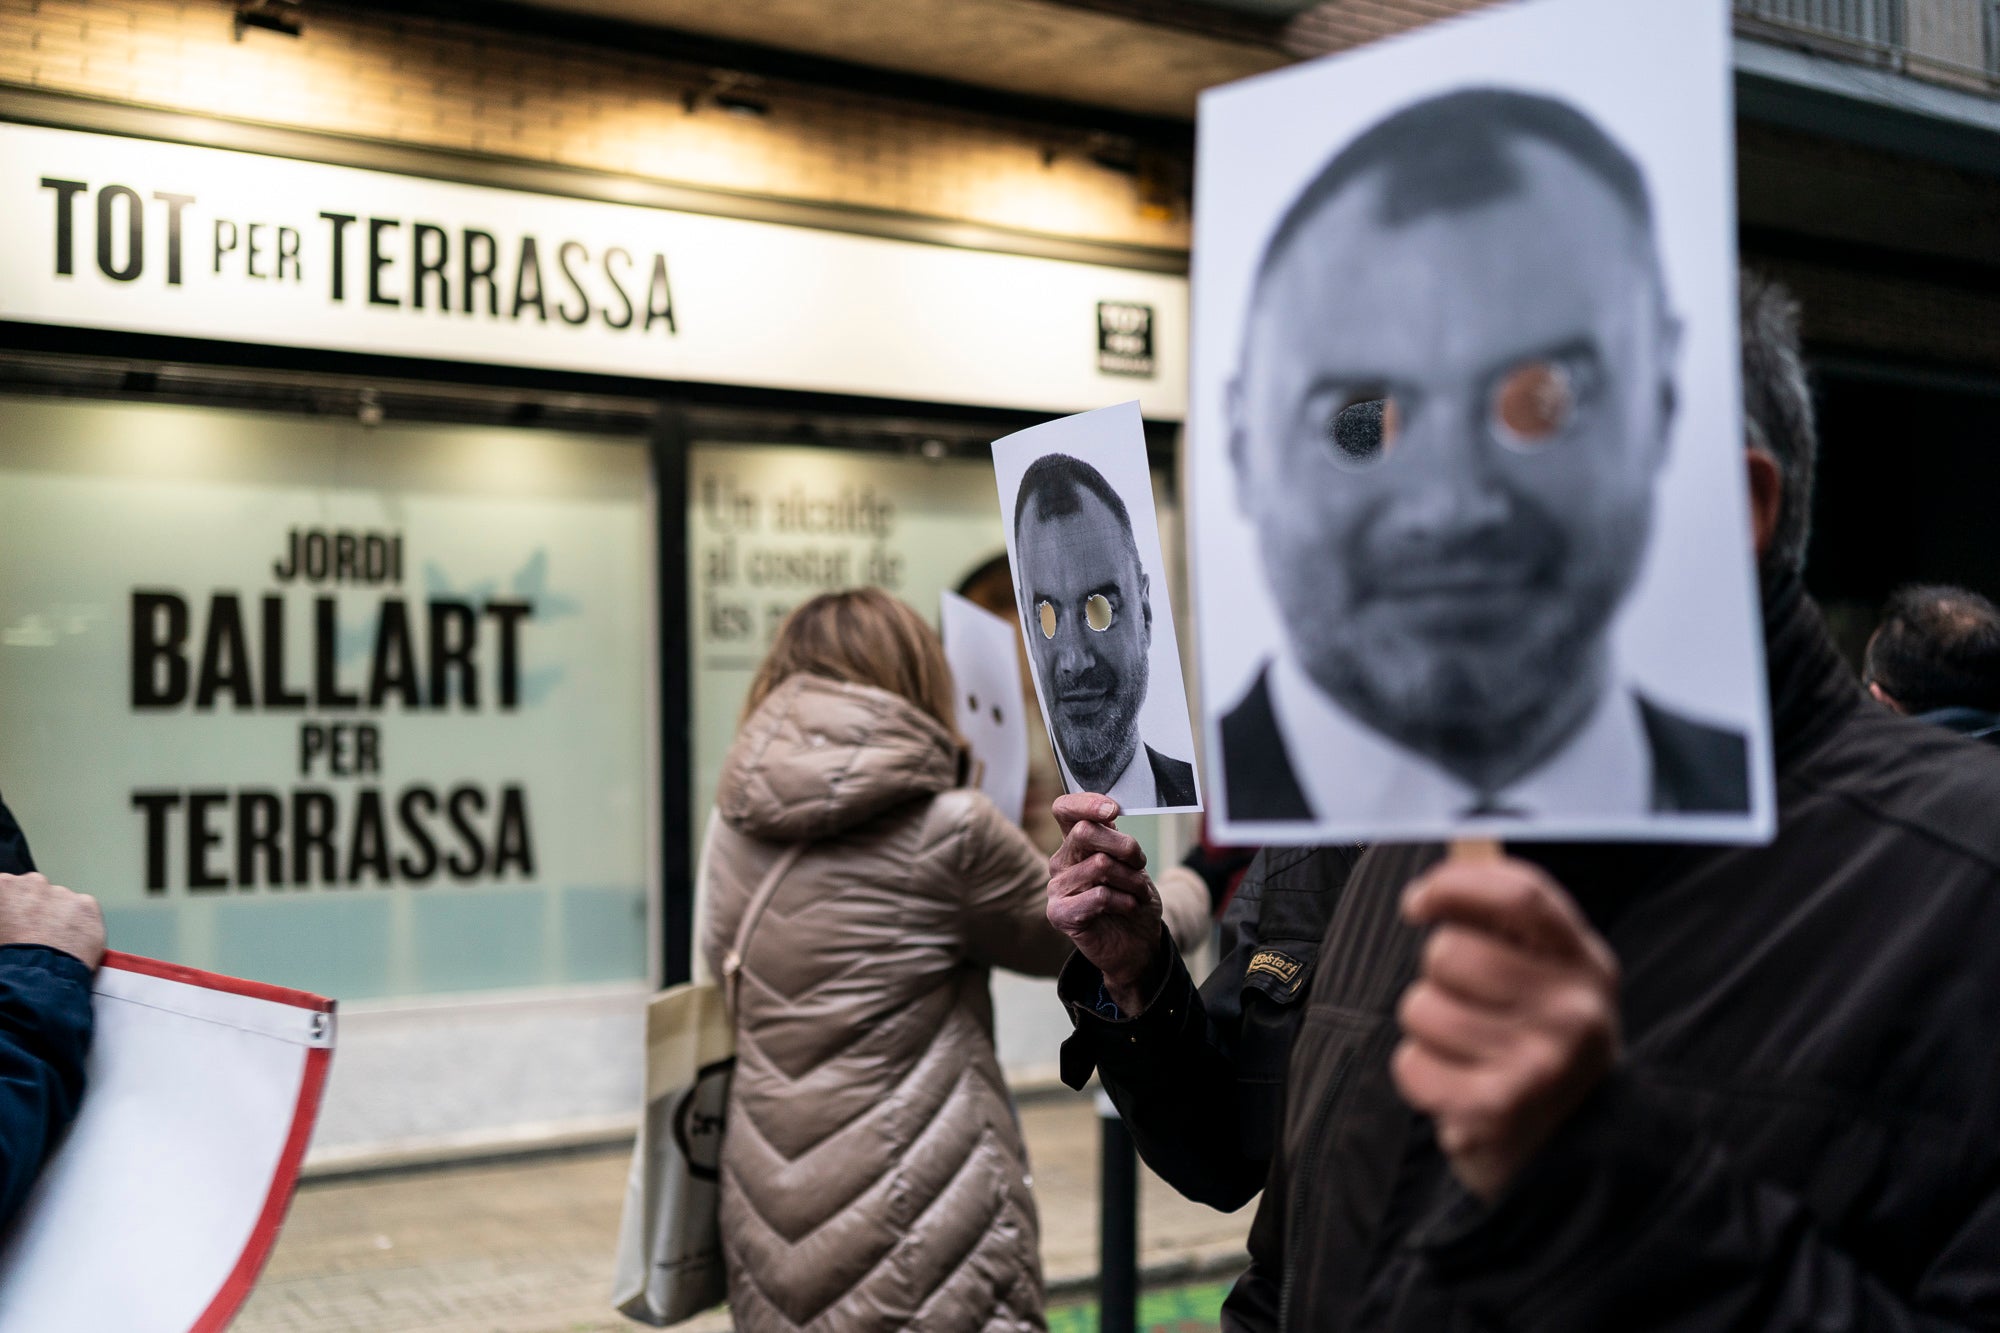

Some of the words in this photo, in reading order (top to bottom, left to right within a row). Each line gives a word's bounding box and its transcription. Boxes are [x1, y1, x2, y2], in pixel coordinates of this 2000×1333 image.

[40, 177, 196, 284] TOT
[214, 218, 303, 281] PER
[319, 210, 677, 335] TERRASSA
[273, 527, 404, 585] JORDI
[130, 588, 534, 713] BALLART
[300, 721, 382, 778] PER
[130, 783, 536, 895] TERRASSA
